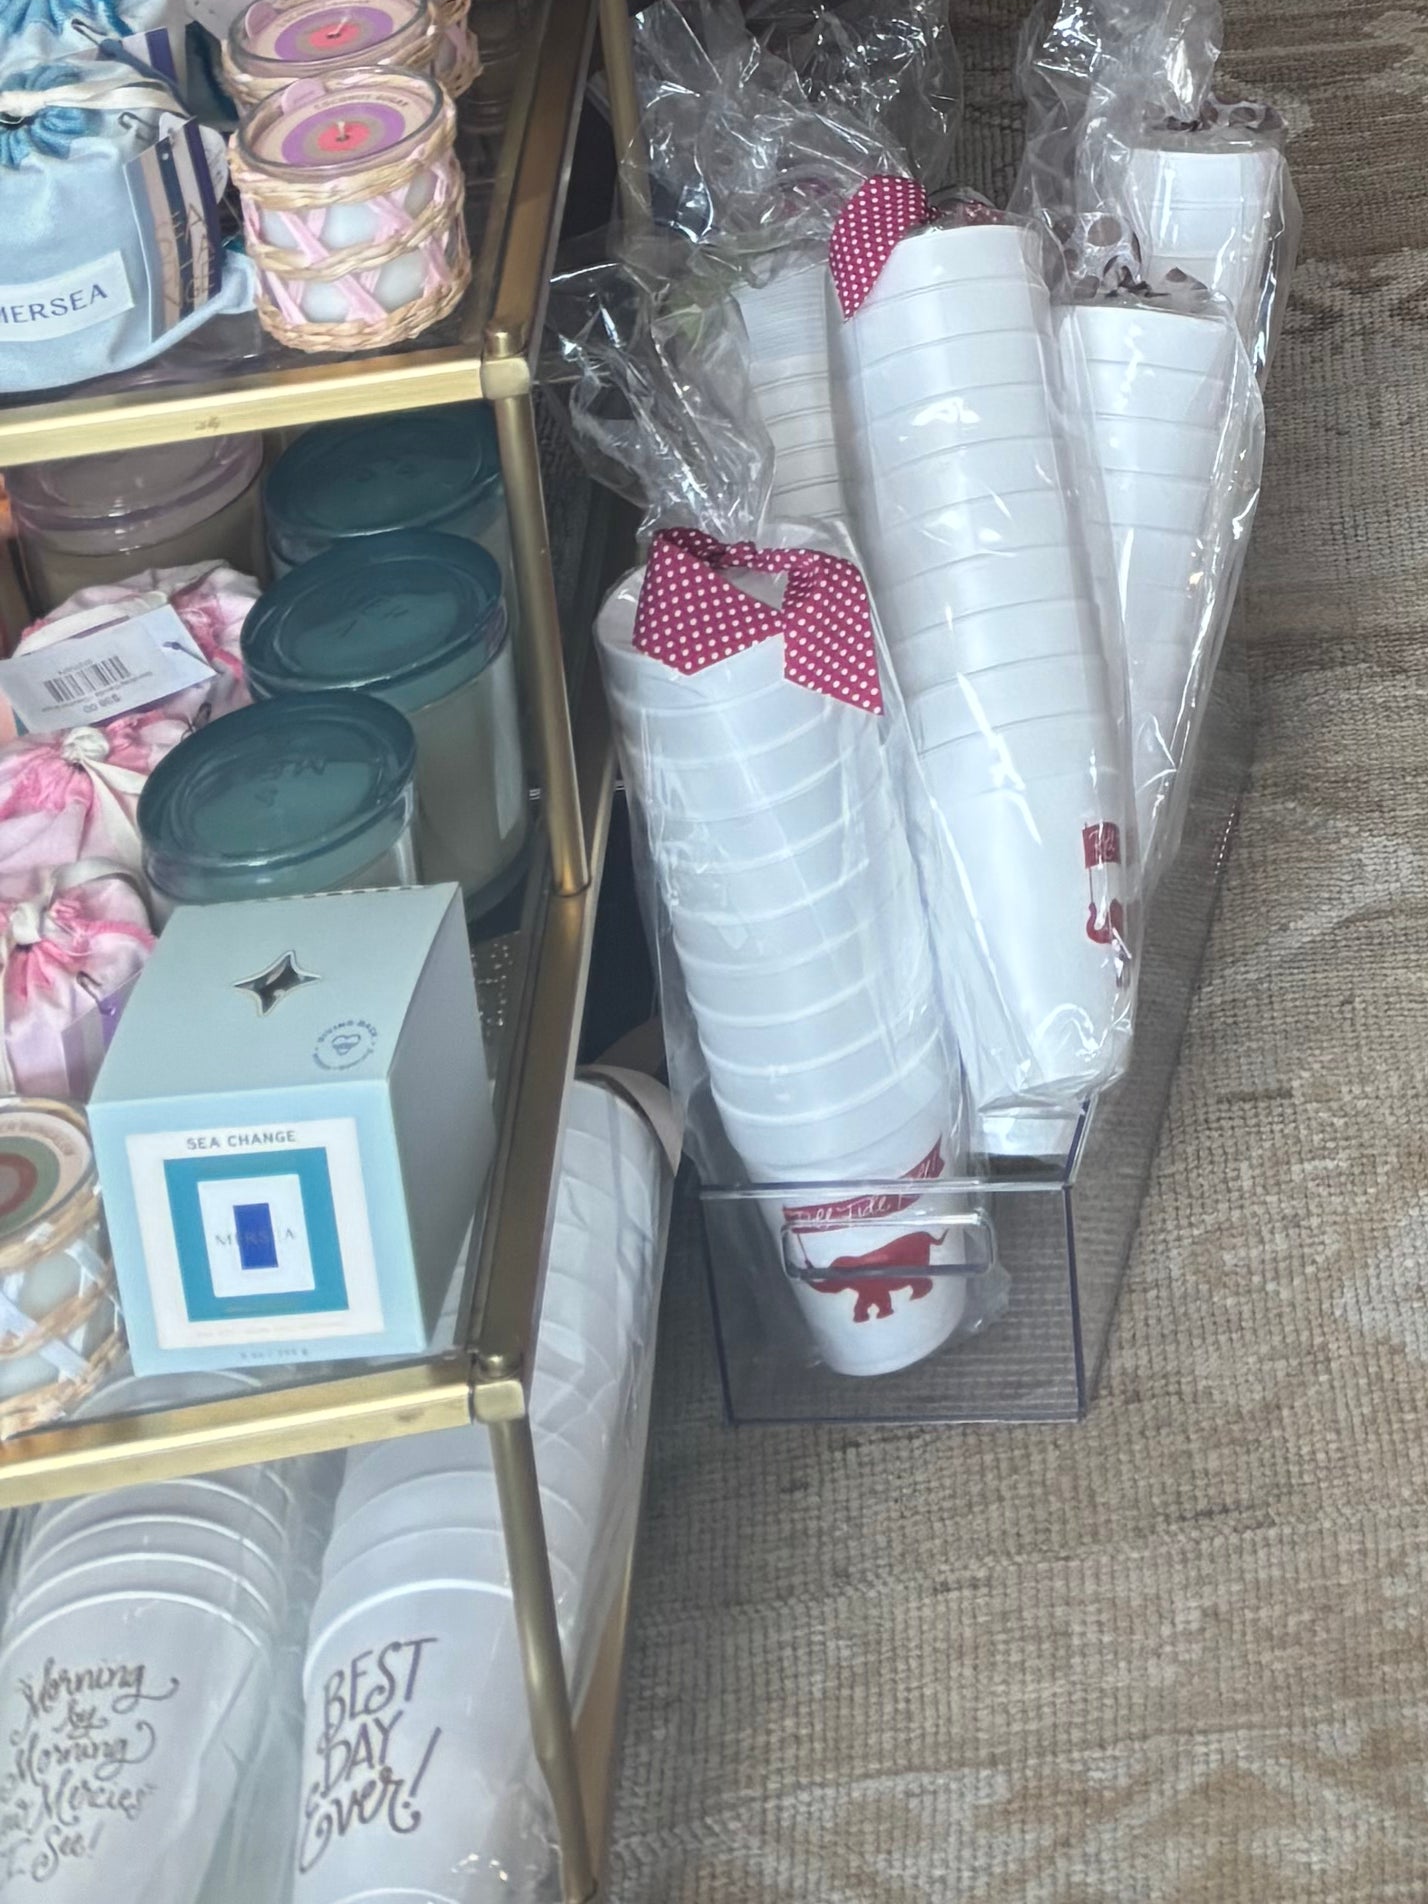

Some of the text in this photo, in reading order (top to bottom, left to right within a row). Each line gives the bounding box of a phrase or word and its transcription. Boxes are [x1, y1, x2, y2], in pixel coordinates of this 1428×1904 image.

[187, 1130, 297, 1150] SEA CHANGE
[316, 1637, 440, 1755] BEST
[320, 1709, 404, 1799] DAY
